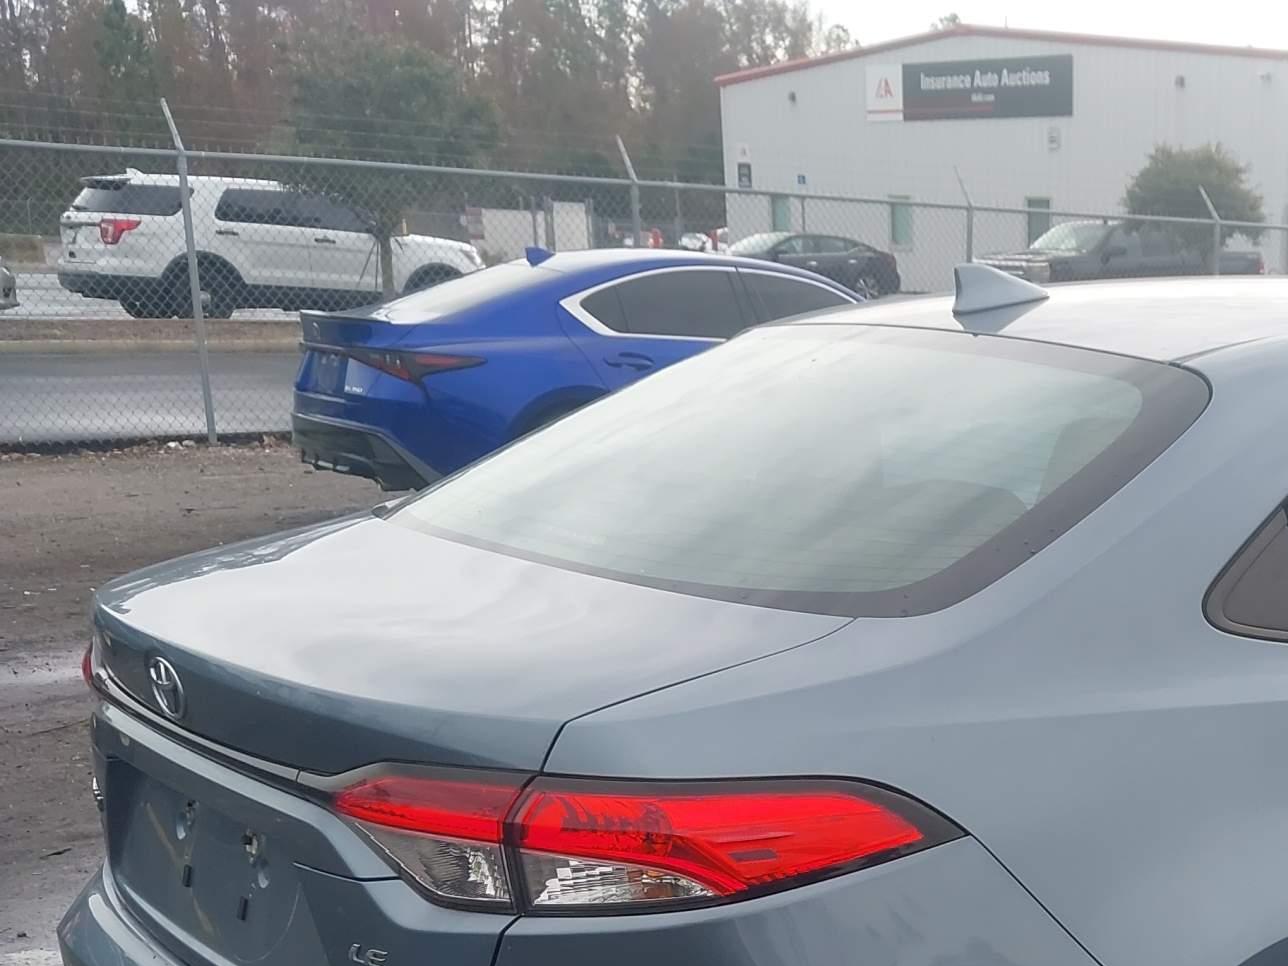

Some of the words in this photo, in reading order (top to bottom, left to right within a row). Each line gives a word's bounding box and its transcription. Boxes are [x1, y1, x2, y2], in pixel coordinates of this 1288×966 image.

[921, 71, 971, 89] Insurance
[974, 69, 998, 88] Auto
[1001, 67, 1050, 87] Auctions
